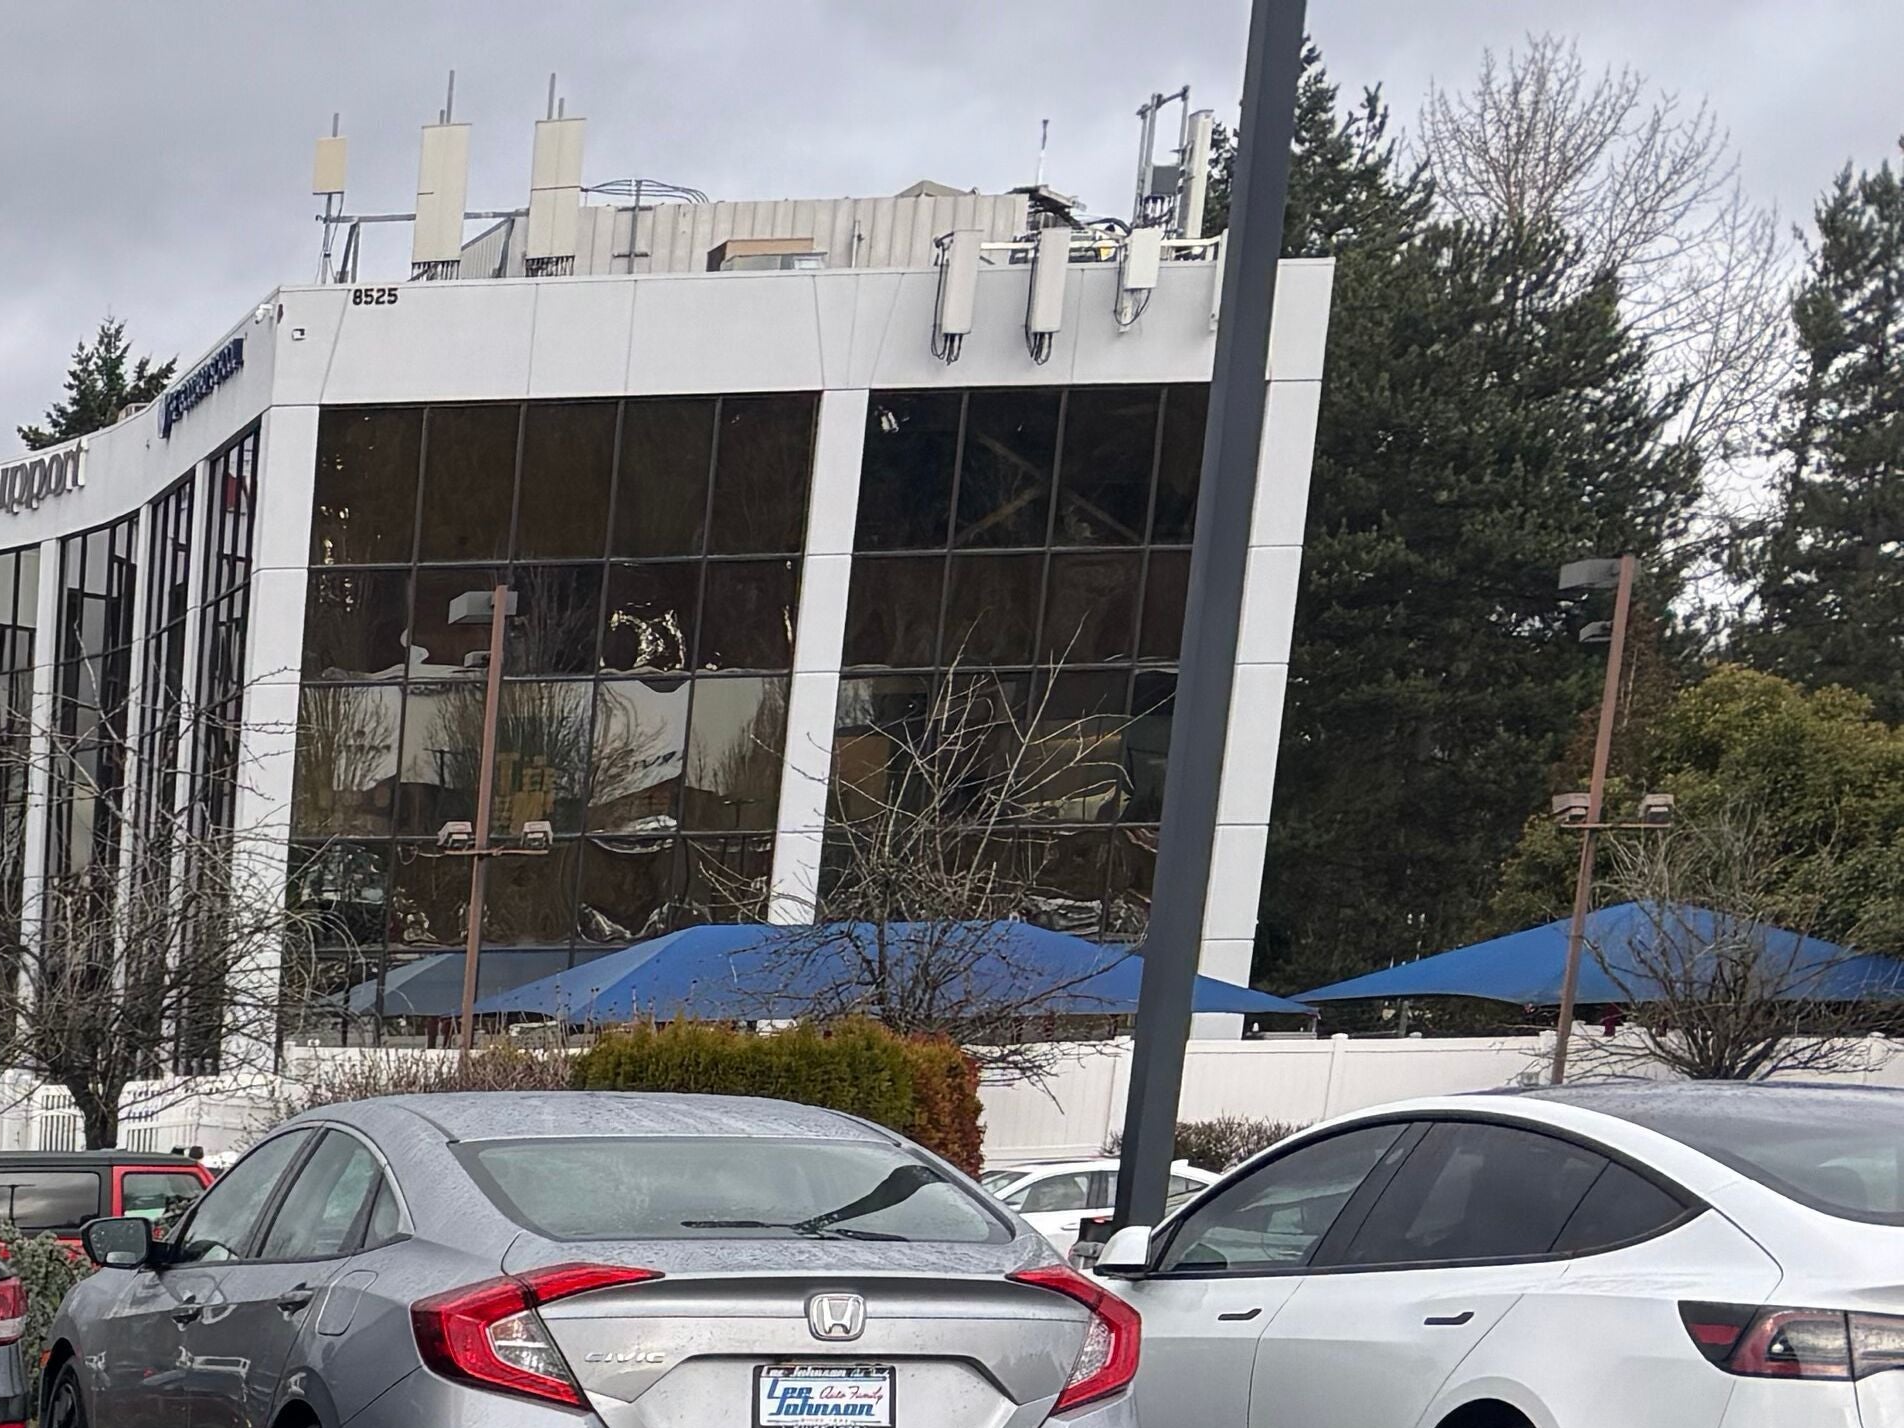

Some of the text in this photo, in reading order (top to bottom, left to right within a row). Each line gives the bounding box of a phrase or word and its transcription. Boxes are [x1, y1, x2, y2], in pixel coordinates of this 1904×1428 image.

[352, 288, 399, 305] 8525
[584, 1351, 666, 1364] CIVIC
[767, 1378, 814, 1400] Lee
[768, 1395, 876, 1417] Johnson
